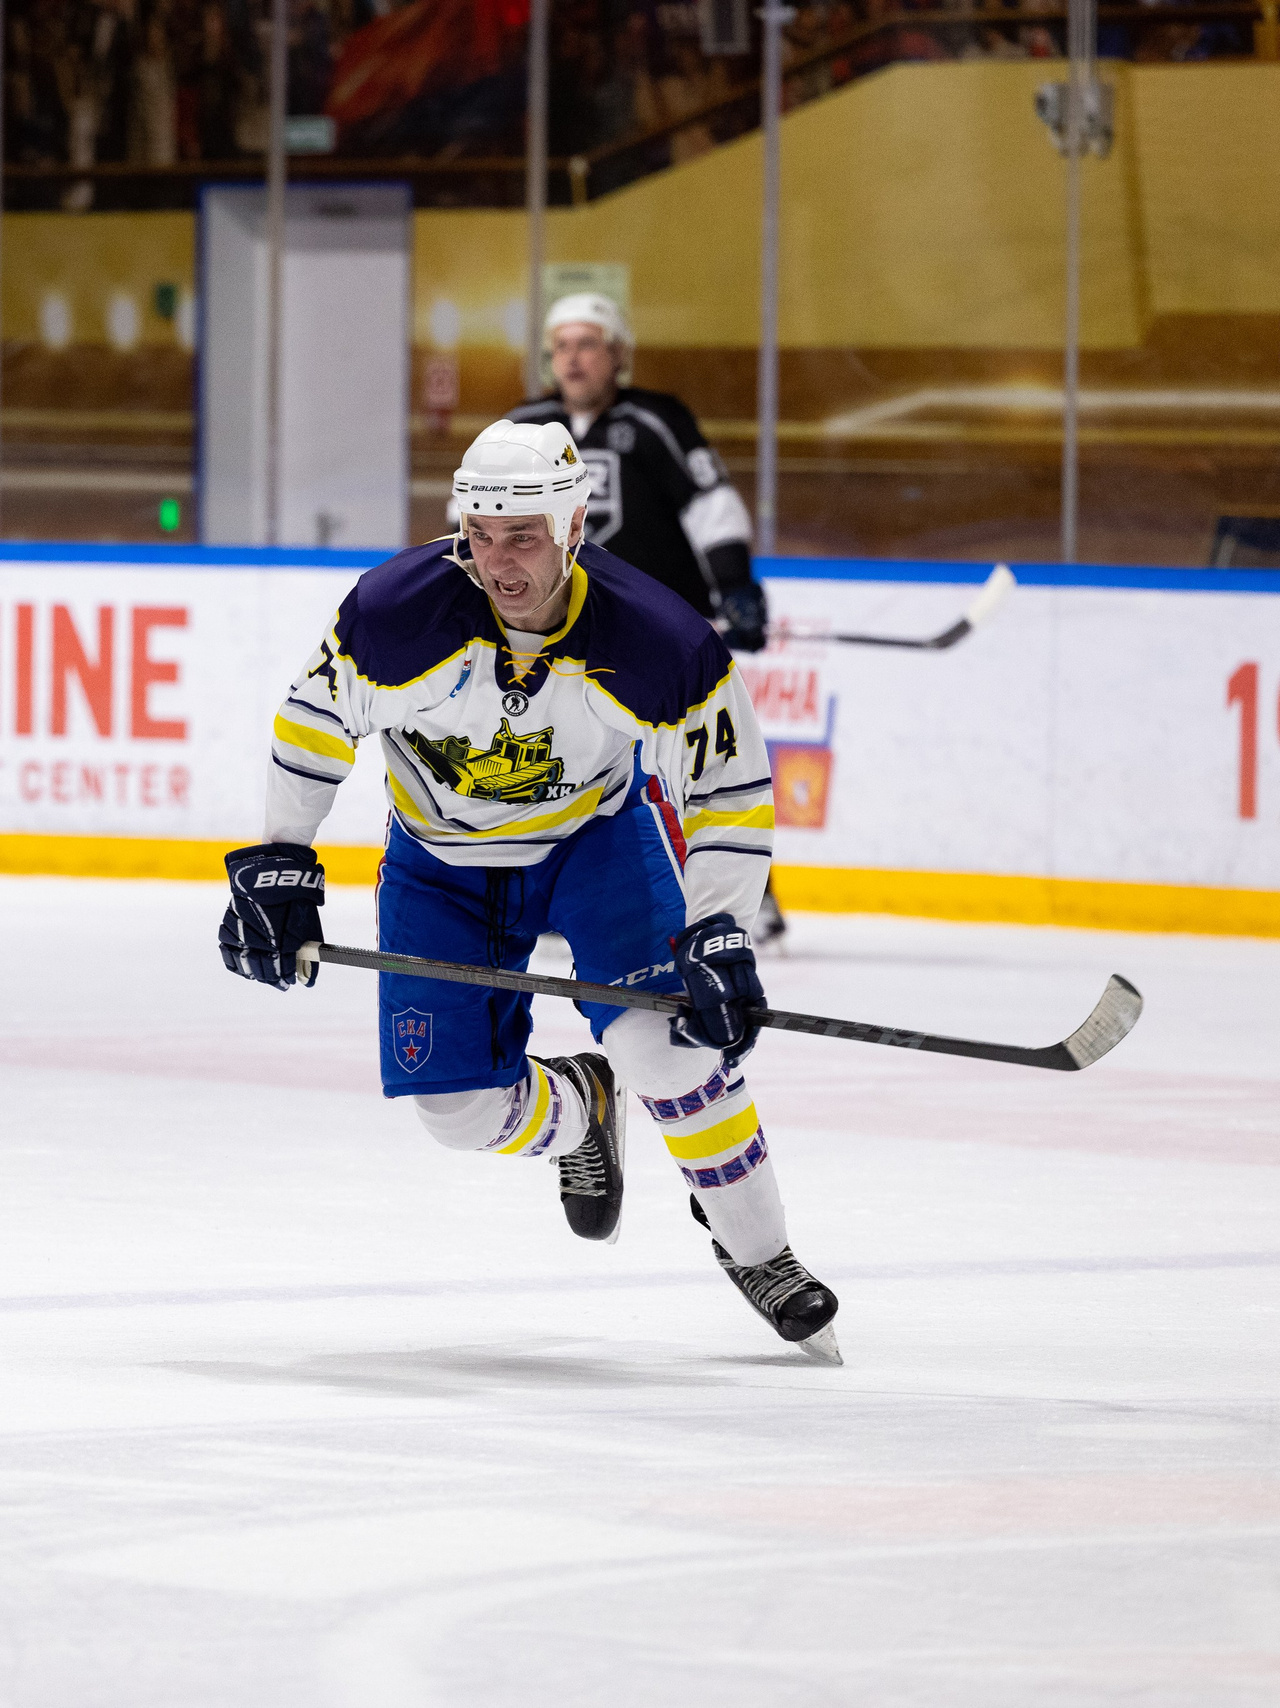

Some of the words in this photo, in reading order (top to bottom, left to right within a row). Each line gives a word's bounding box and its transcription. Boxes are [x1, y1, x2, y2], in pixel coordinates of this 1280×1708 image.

[470, 484, 508, 493] BAUER
[684, 706, 738, 782] 74
[1227, 661, 1280, 820] 1
[19, 760, 192, 807] CENTER
[445, 968, 558, 995] RIBCOR
[397, 1018, 427, 1039] СКА
